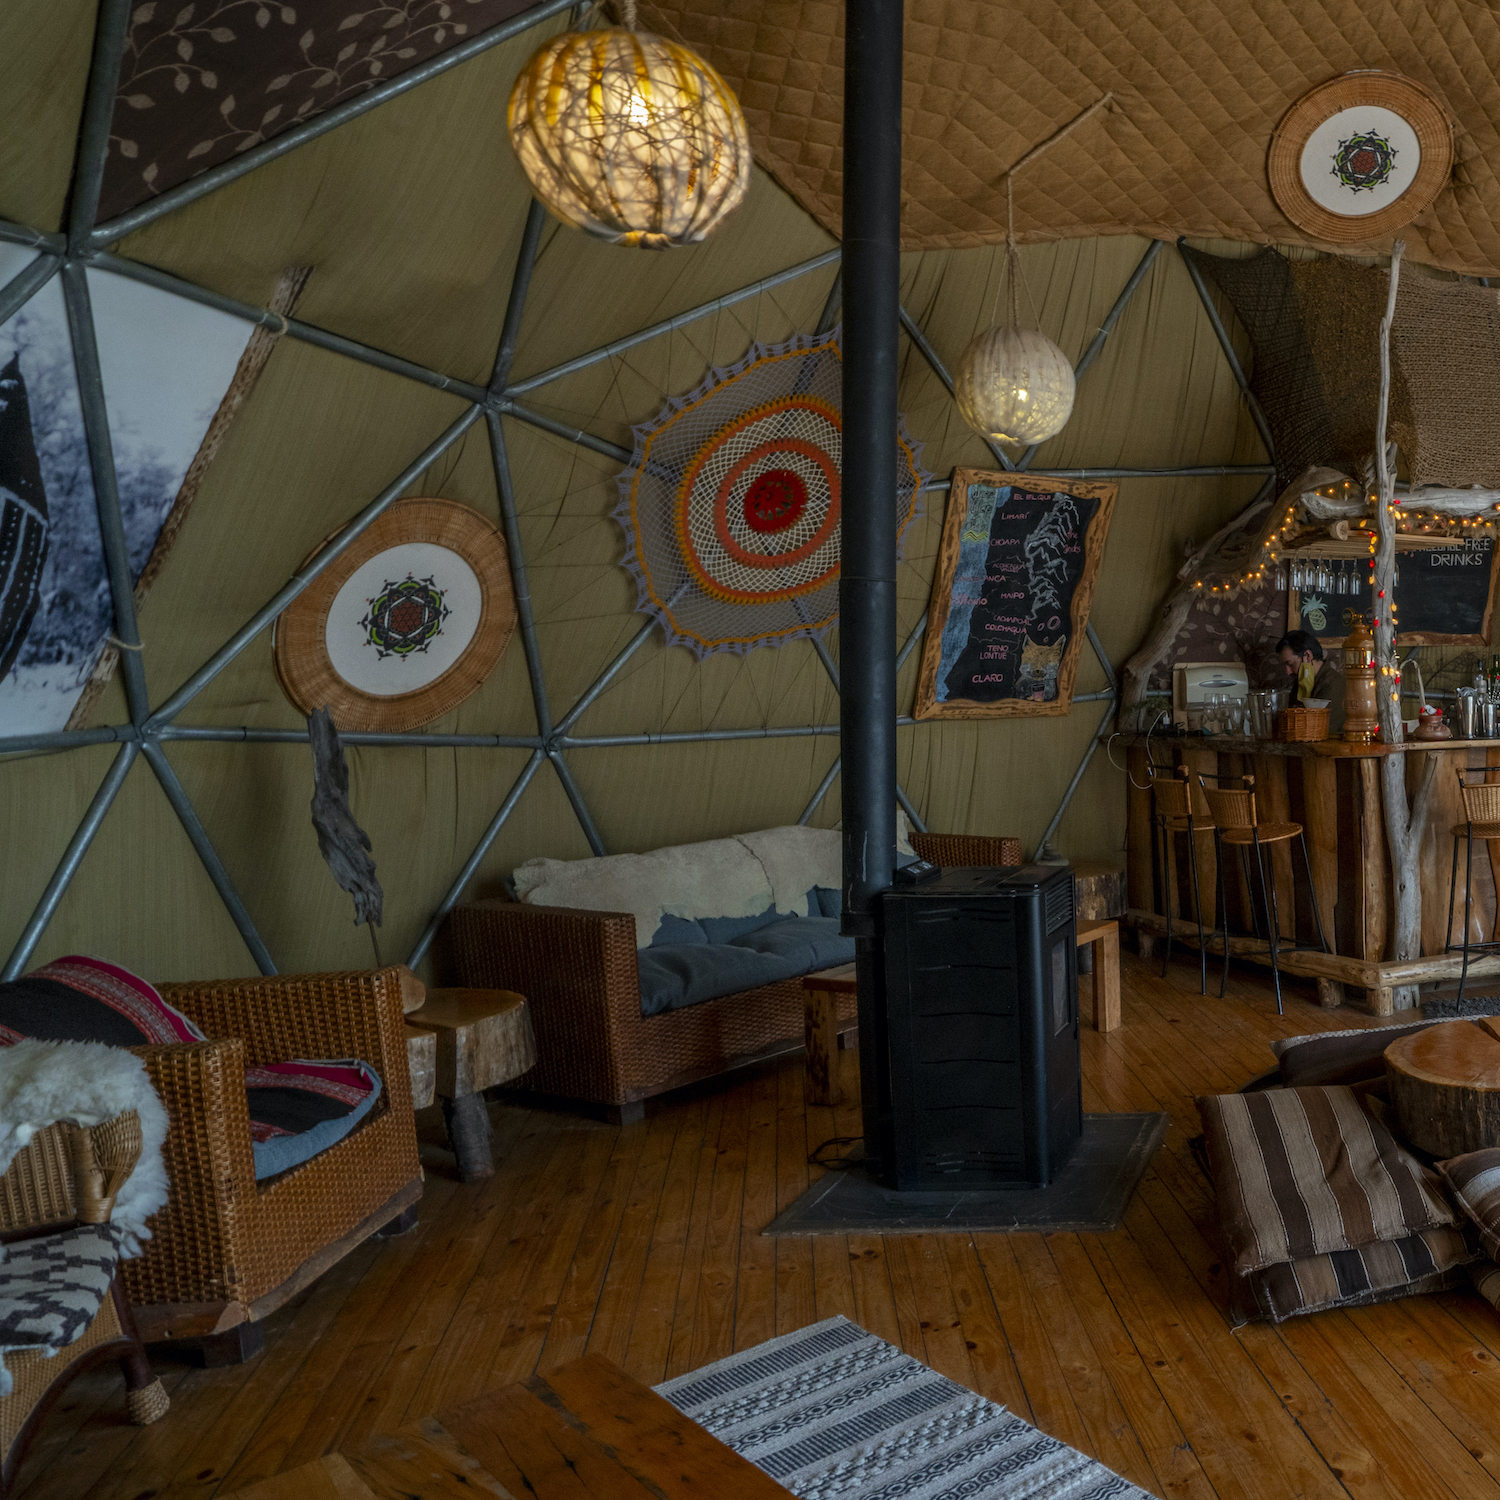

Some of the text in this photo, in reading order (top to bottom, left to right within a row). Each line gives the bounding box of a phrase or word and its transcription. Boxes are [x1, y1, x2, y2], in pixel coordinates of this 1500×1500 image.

[1001, 512, 1030, 520] LIMARÍ
[990, 538, 1020, 546] CHOAPA
[1465, 538, 1492, 551] FREE
[1431, 553, 1483, 567] DRINKS
[985, 623, 1027, 635] COLCHAGUA
[987, 644, 1009, 652] TENO
[972, 673, 1003, 683] CLARO
